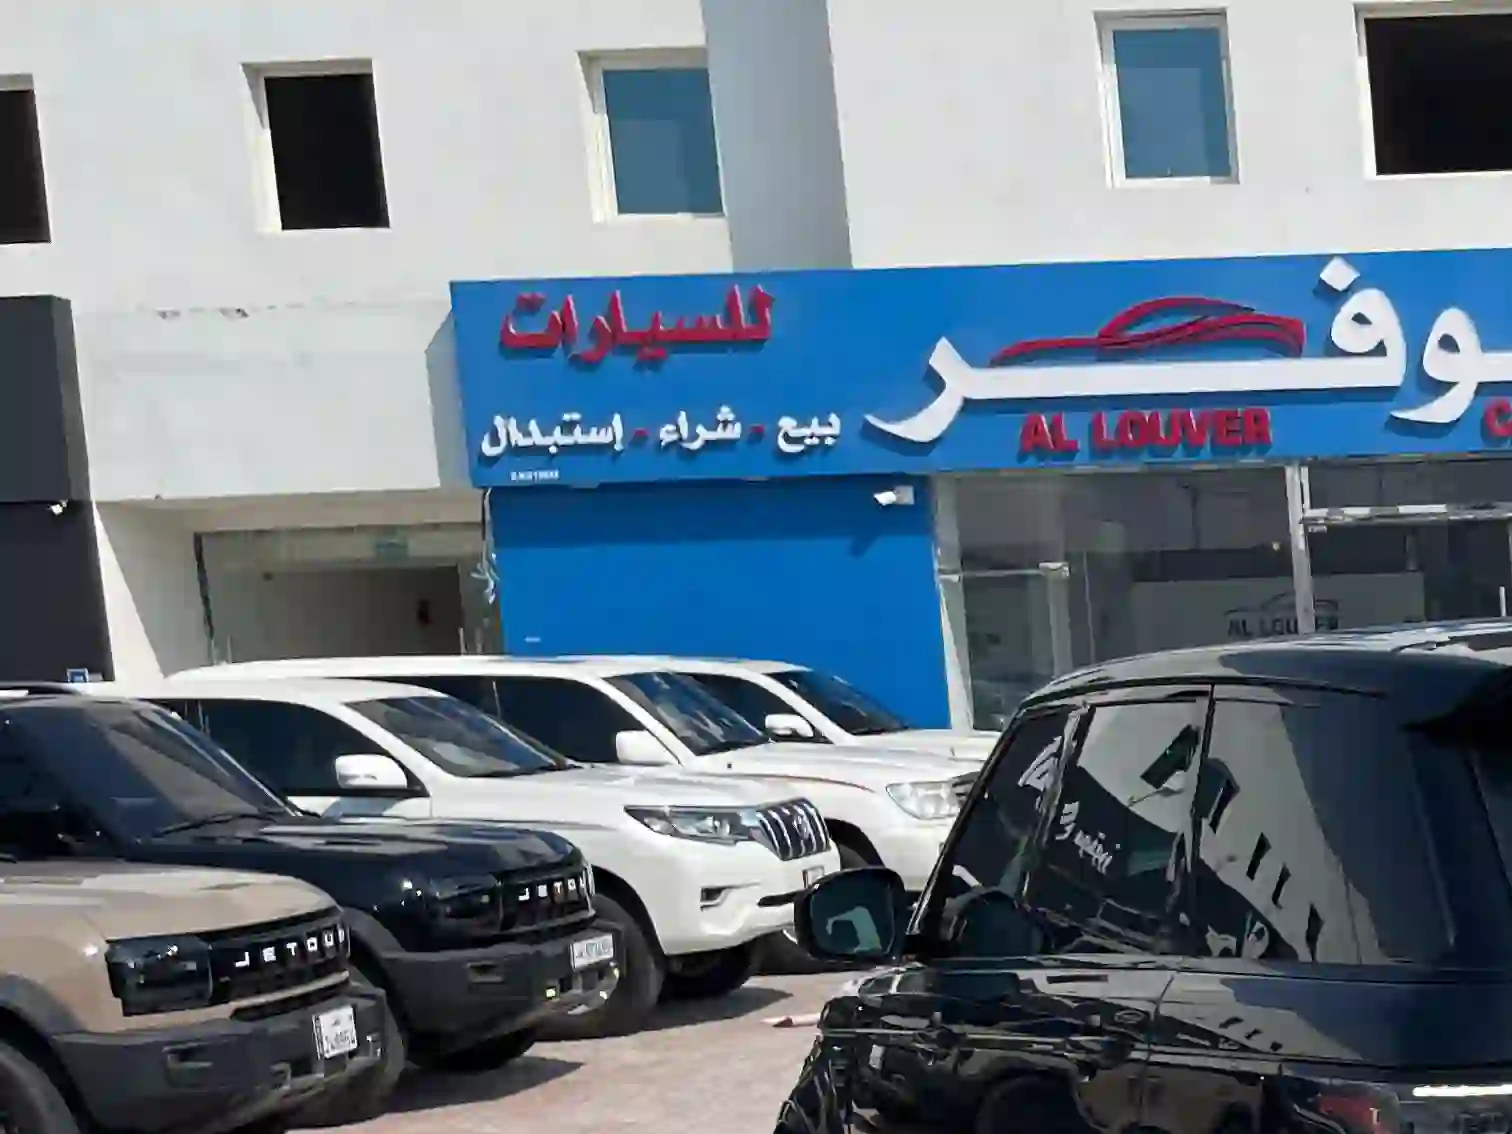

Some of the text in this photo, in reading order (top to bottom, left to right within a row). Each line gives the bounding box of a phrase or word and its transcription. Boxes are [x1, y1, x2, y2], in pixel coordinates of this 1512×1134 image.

[499, 284, 775, 362] للسيارات
[658, 404, 742, 450] شراء
[776, 411, 841, 453] بيع
[1019, 406, 1271, 453] AL LOUVER
